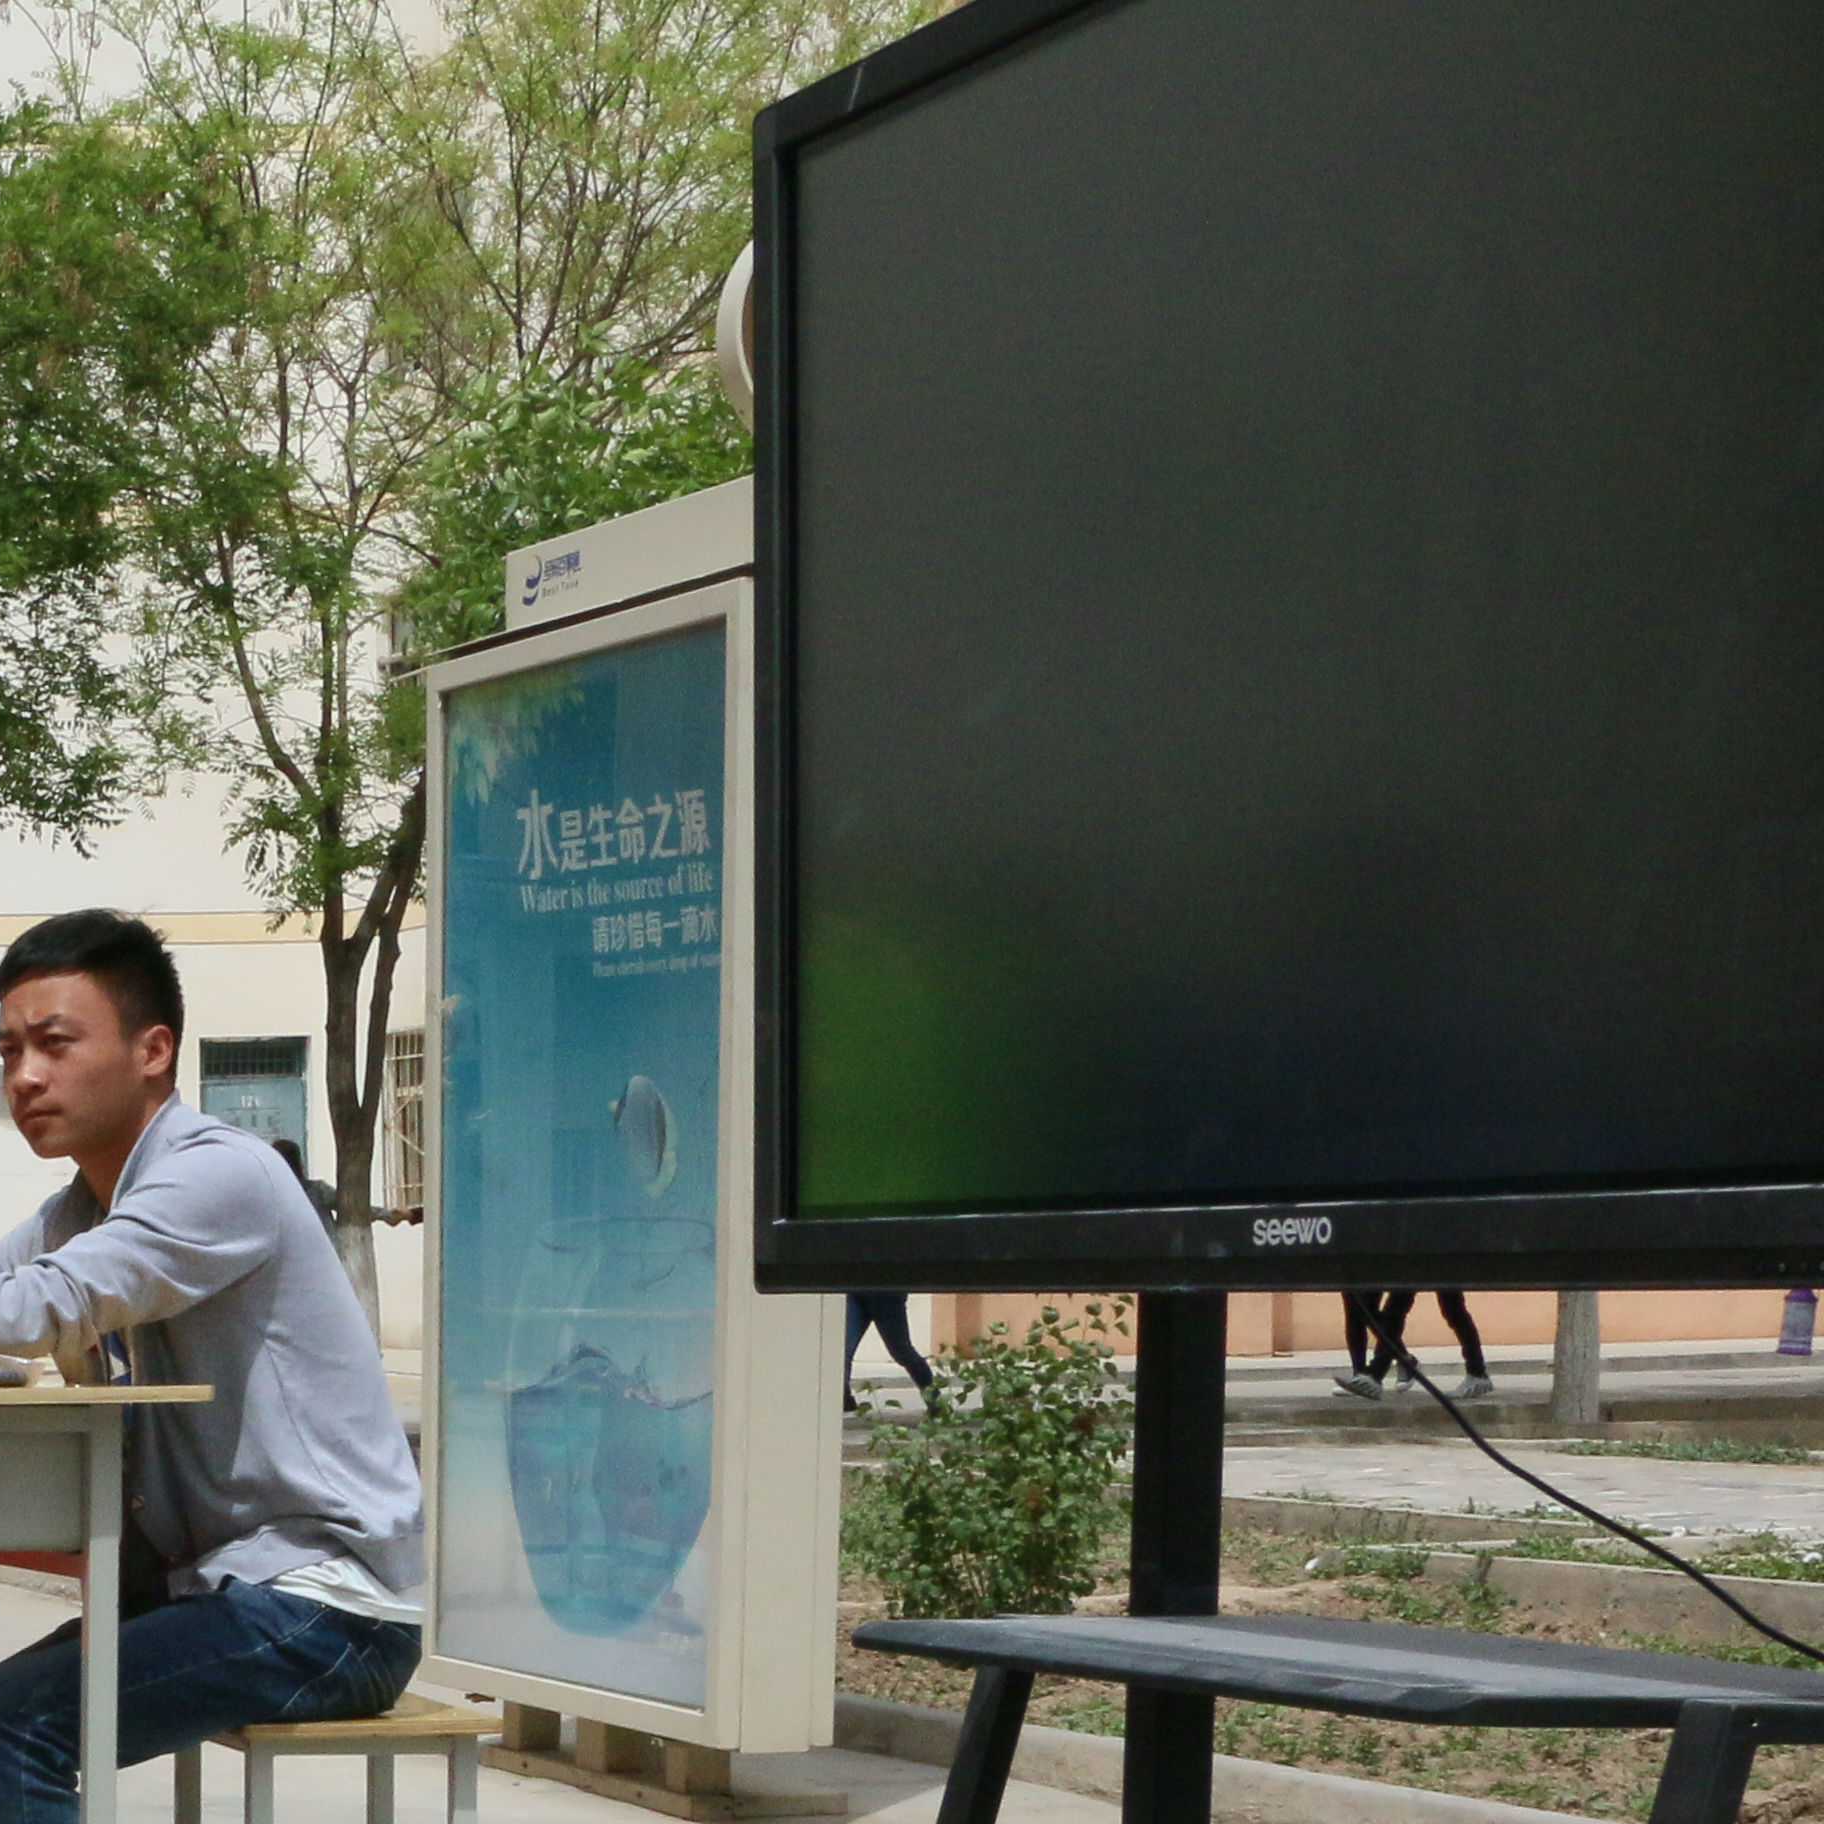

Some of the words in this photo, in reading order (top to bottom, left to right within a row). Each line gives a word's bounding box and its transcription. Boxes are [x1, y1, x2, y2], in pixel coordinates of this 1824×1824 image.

[517, 788, 710, 880] 水是生命之源
[521, 884, 568, 913] Water
[571, 878, 584, 908] is
[587, 877, 611, 906] the
[614, 876, 664, 902] source
[668, 863, 685, 895] of
[687, 860, 714, 893] life
[592, 904, 719, 953] 请珍惜每一滴水
[1252, 1216, 1332, 1246] seewo
